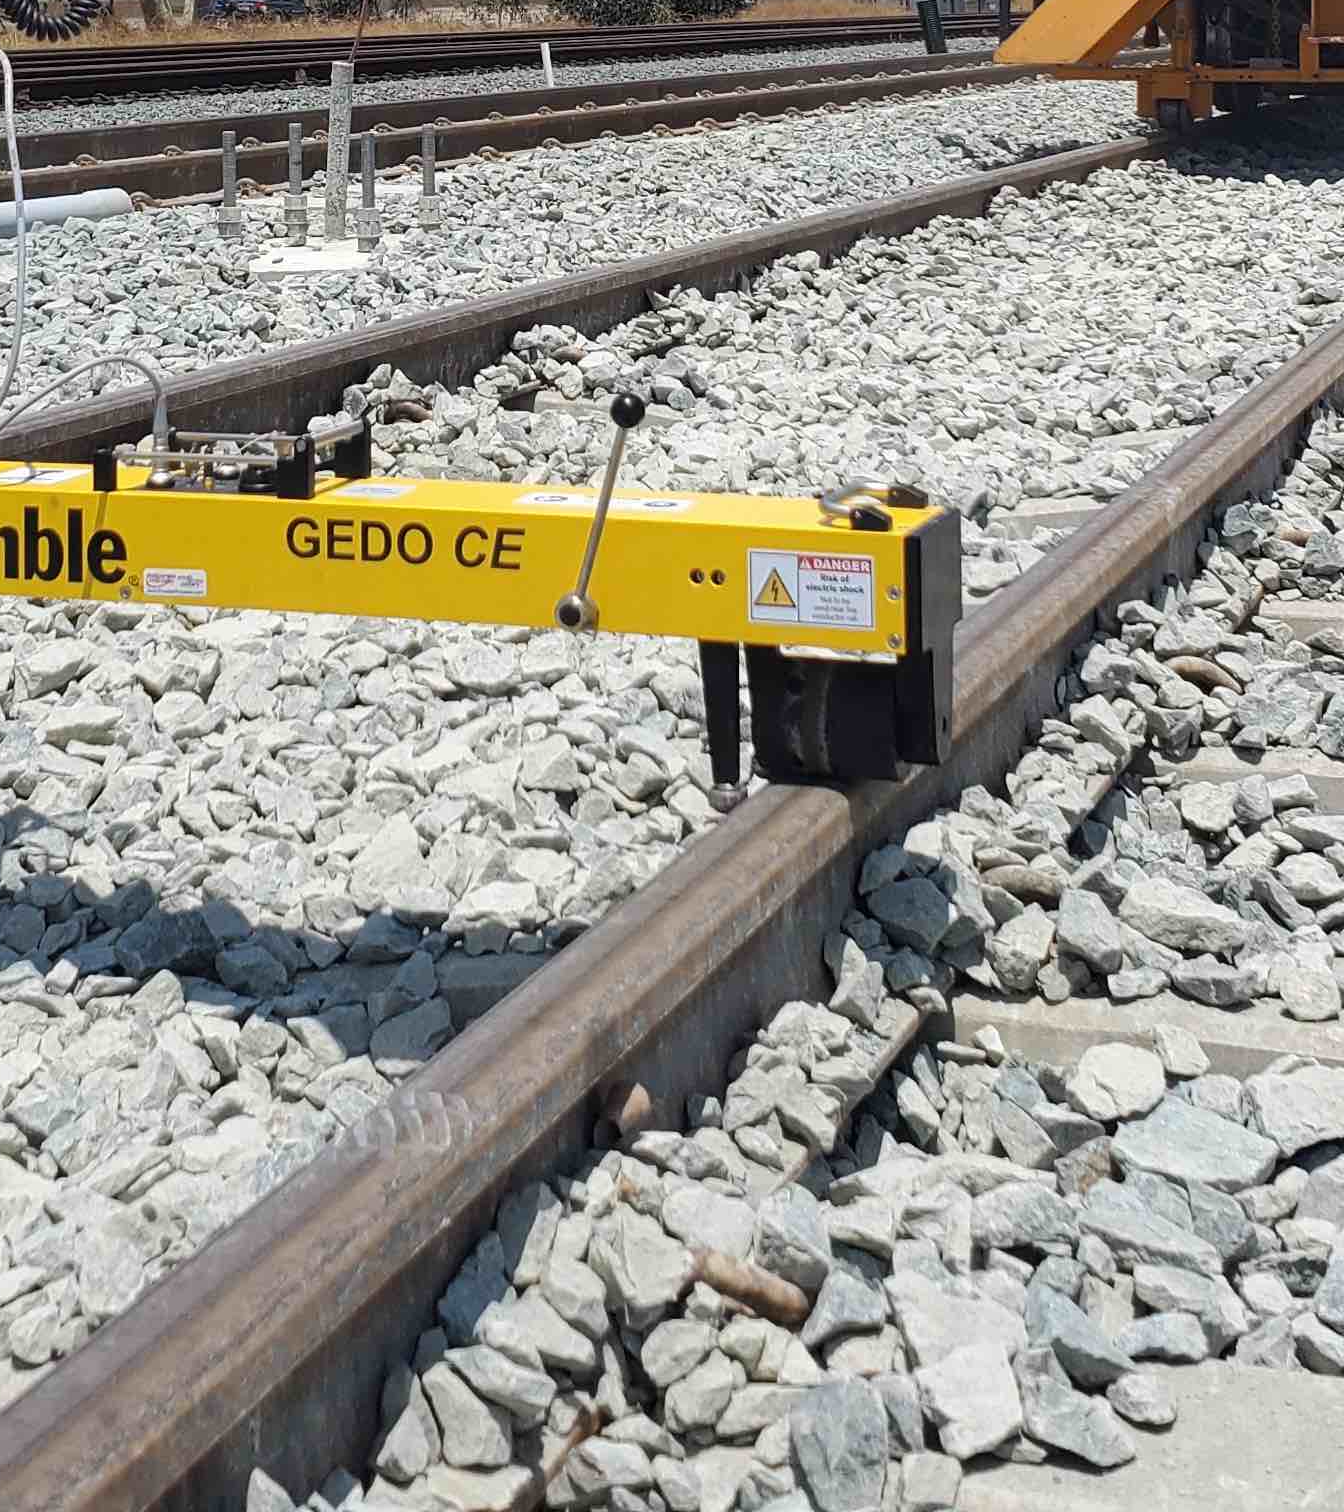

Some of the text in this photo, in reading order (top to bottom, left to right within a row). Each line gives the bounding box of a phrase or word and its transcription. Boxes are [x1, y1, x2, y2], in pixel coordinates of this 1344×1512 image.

[286, 517, 526, 570] GEDO CE
[813, 558, 870, 572] DANGER
[820, 573, 849, 583] Risk of
[839, 585, 865, 594] shock
